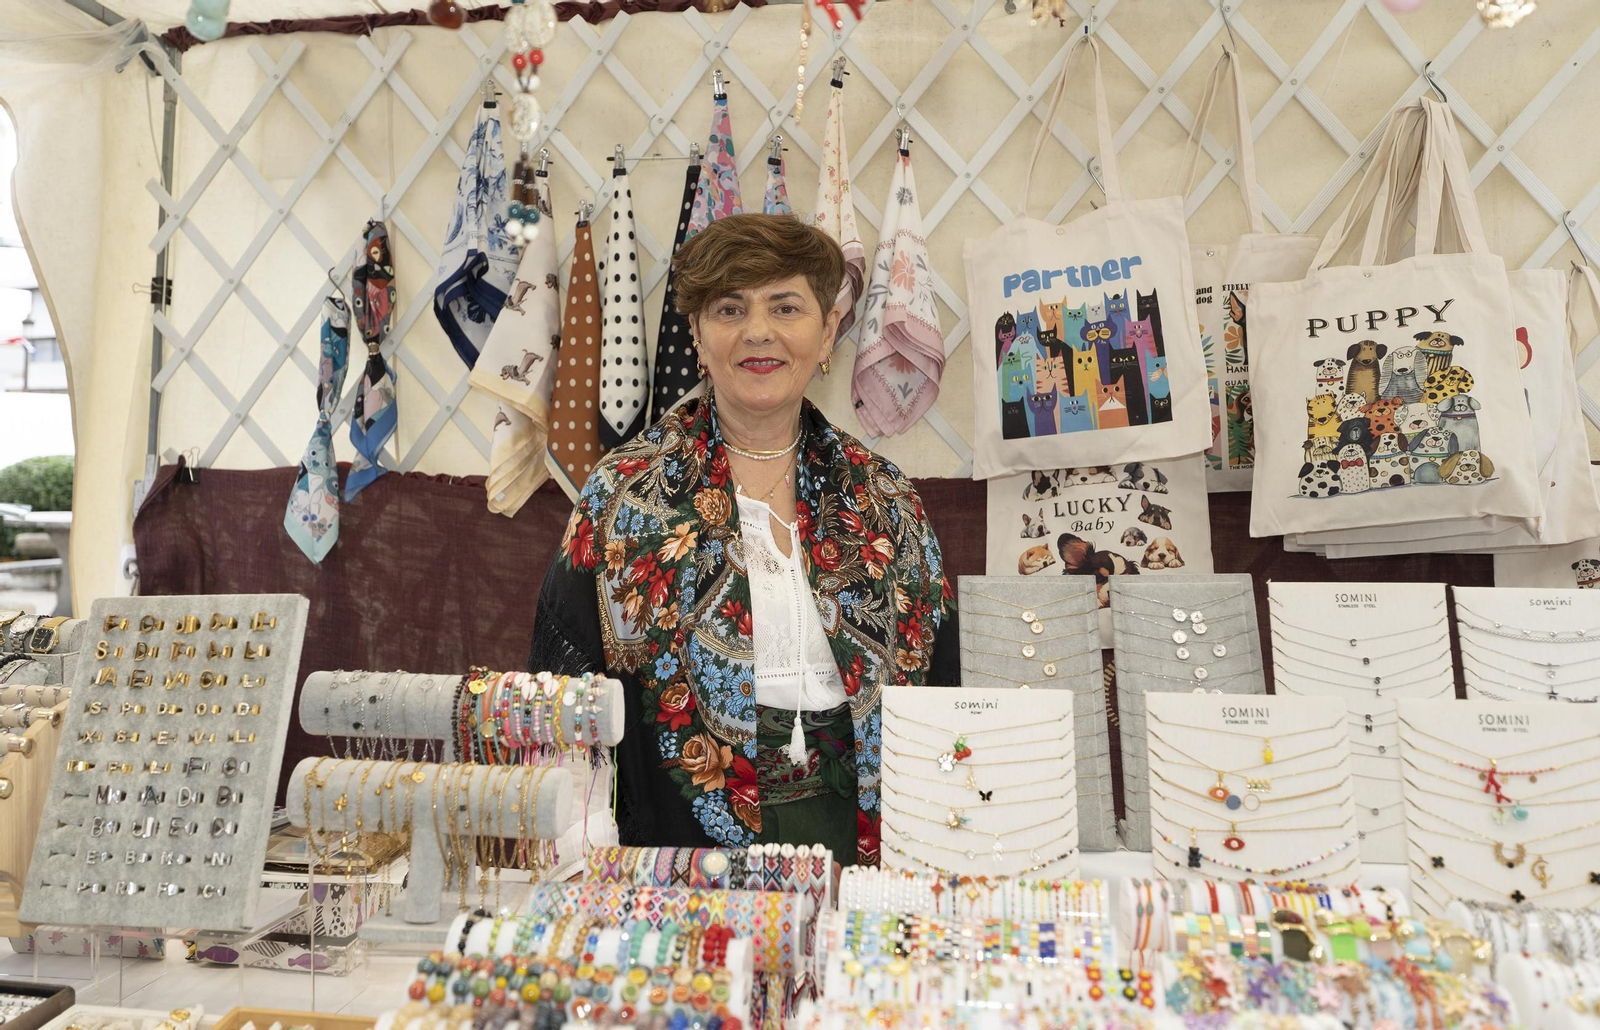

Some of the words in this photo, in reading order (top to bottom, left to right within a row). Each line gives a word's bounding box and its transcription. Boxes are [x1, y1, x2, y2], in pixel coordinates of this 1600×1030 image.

[1003, 255, 1142, 298] partner
[1195, 286, 1213, 295] and
[1222, 283, 1250, 291] FIDELI
[1196, 295, 1213, 305] dog
[1306, 298, 1455, 338] PUPPY
[1053, 492, 1132, 518] LUCKY
[1070, 516, 1114, 534] Baby
[1335, 593, 1378, 603] SOMINI
[1529, 596, 1572, 606] somini
[95, 640, 109, 660] S
[129, 669, 146, 689] E
[89, 702, 101, 715] S
[121, 702, 133, 715] P
[954, 698, 999, 709] somini
[1221, 707, 1269, 718] SOMINI
[1478, 714, 1530, 725] SOMINI
[156, 731, 169, 744] E
[234, 729, 246, 743] L
